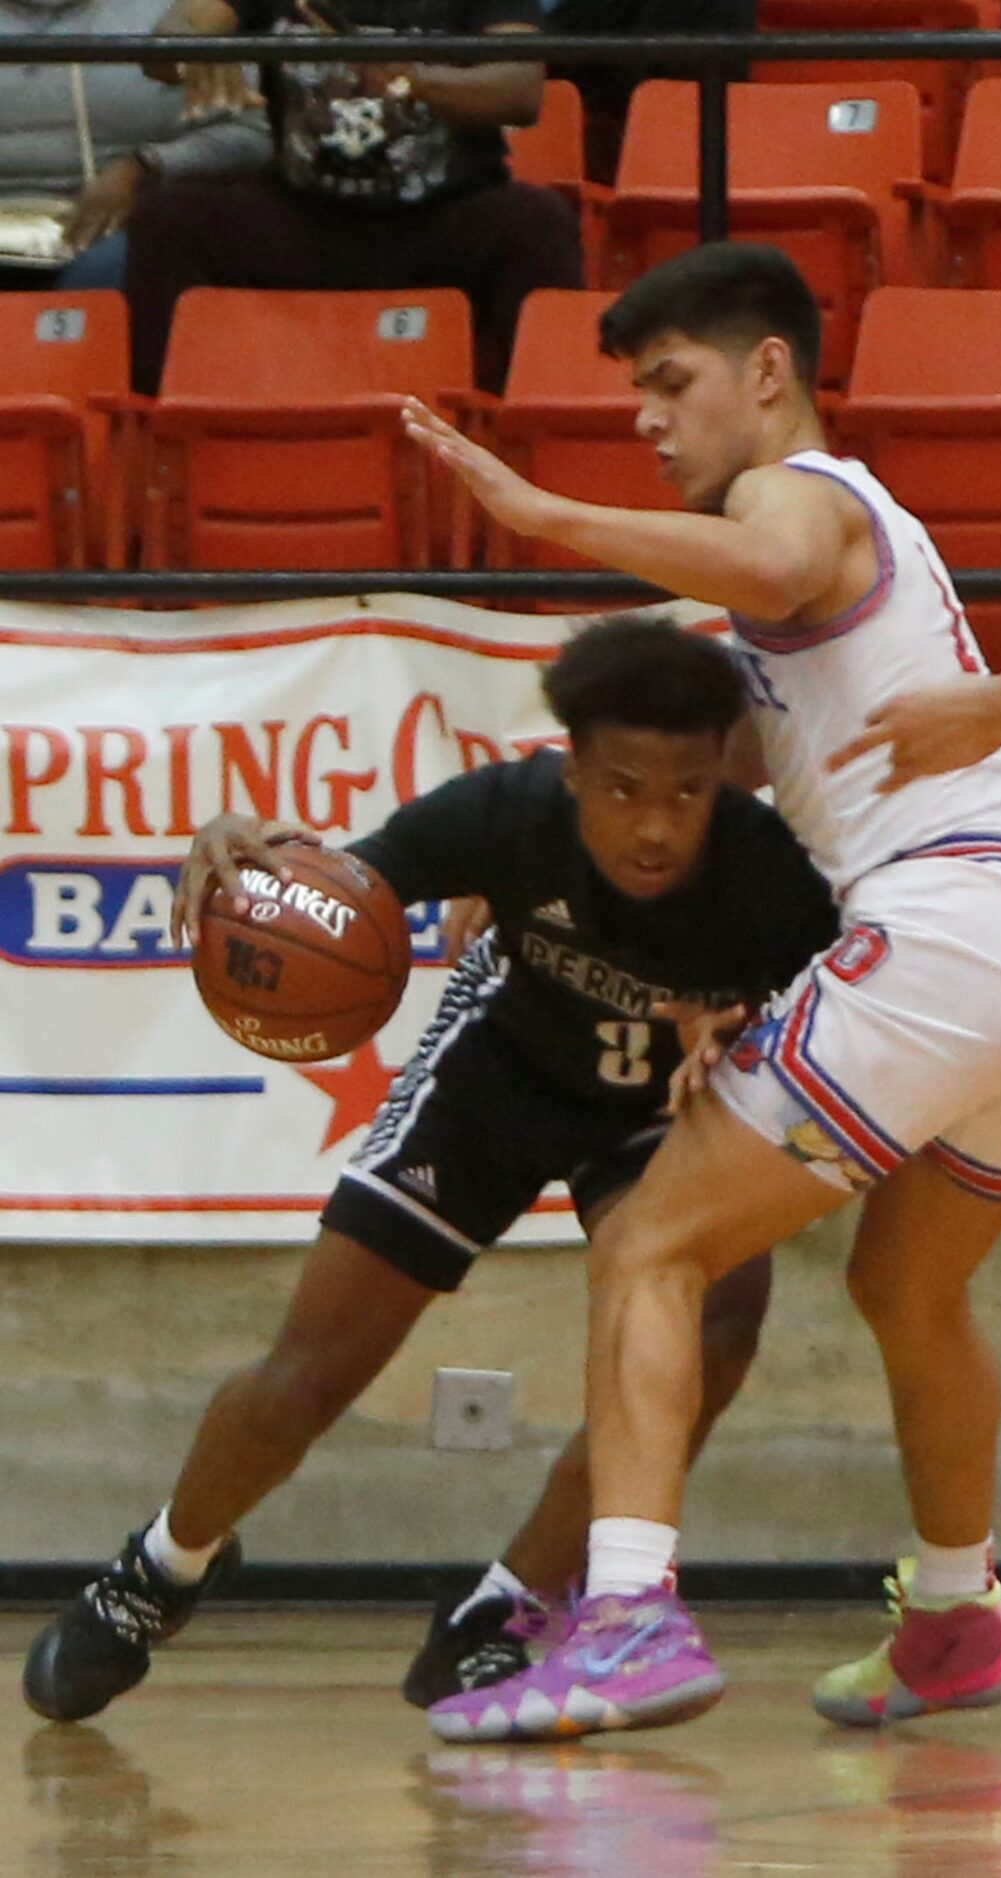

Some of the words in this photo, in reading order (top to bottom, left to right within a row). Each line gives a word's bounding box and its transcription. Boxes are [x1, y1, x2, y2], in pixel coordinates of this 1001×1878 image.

[847, 102, 862, 128] 7
[53, 310, 67, 337] 5
[394, 309, 410, 336] 6
[239, 867, 359, 939] SPALDIN
[521, 931, 742, 1019] PERM
[595, 1020, 652, 1087] 3
